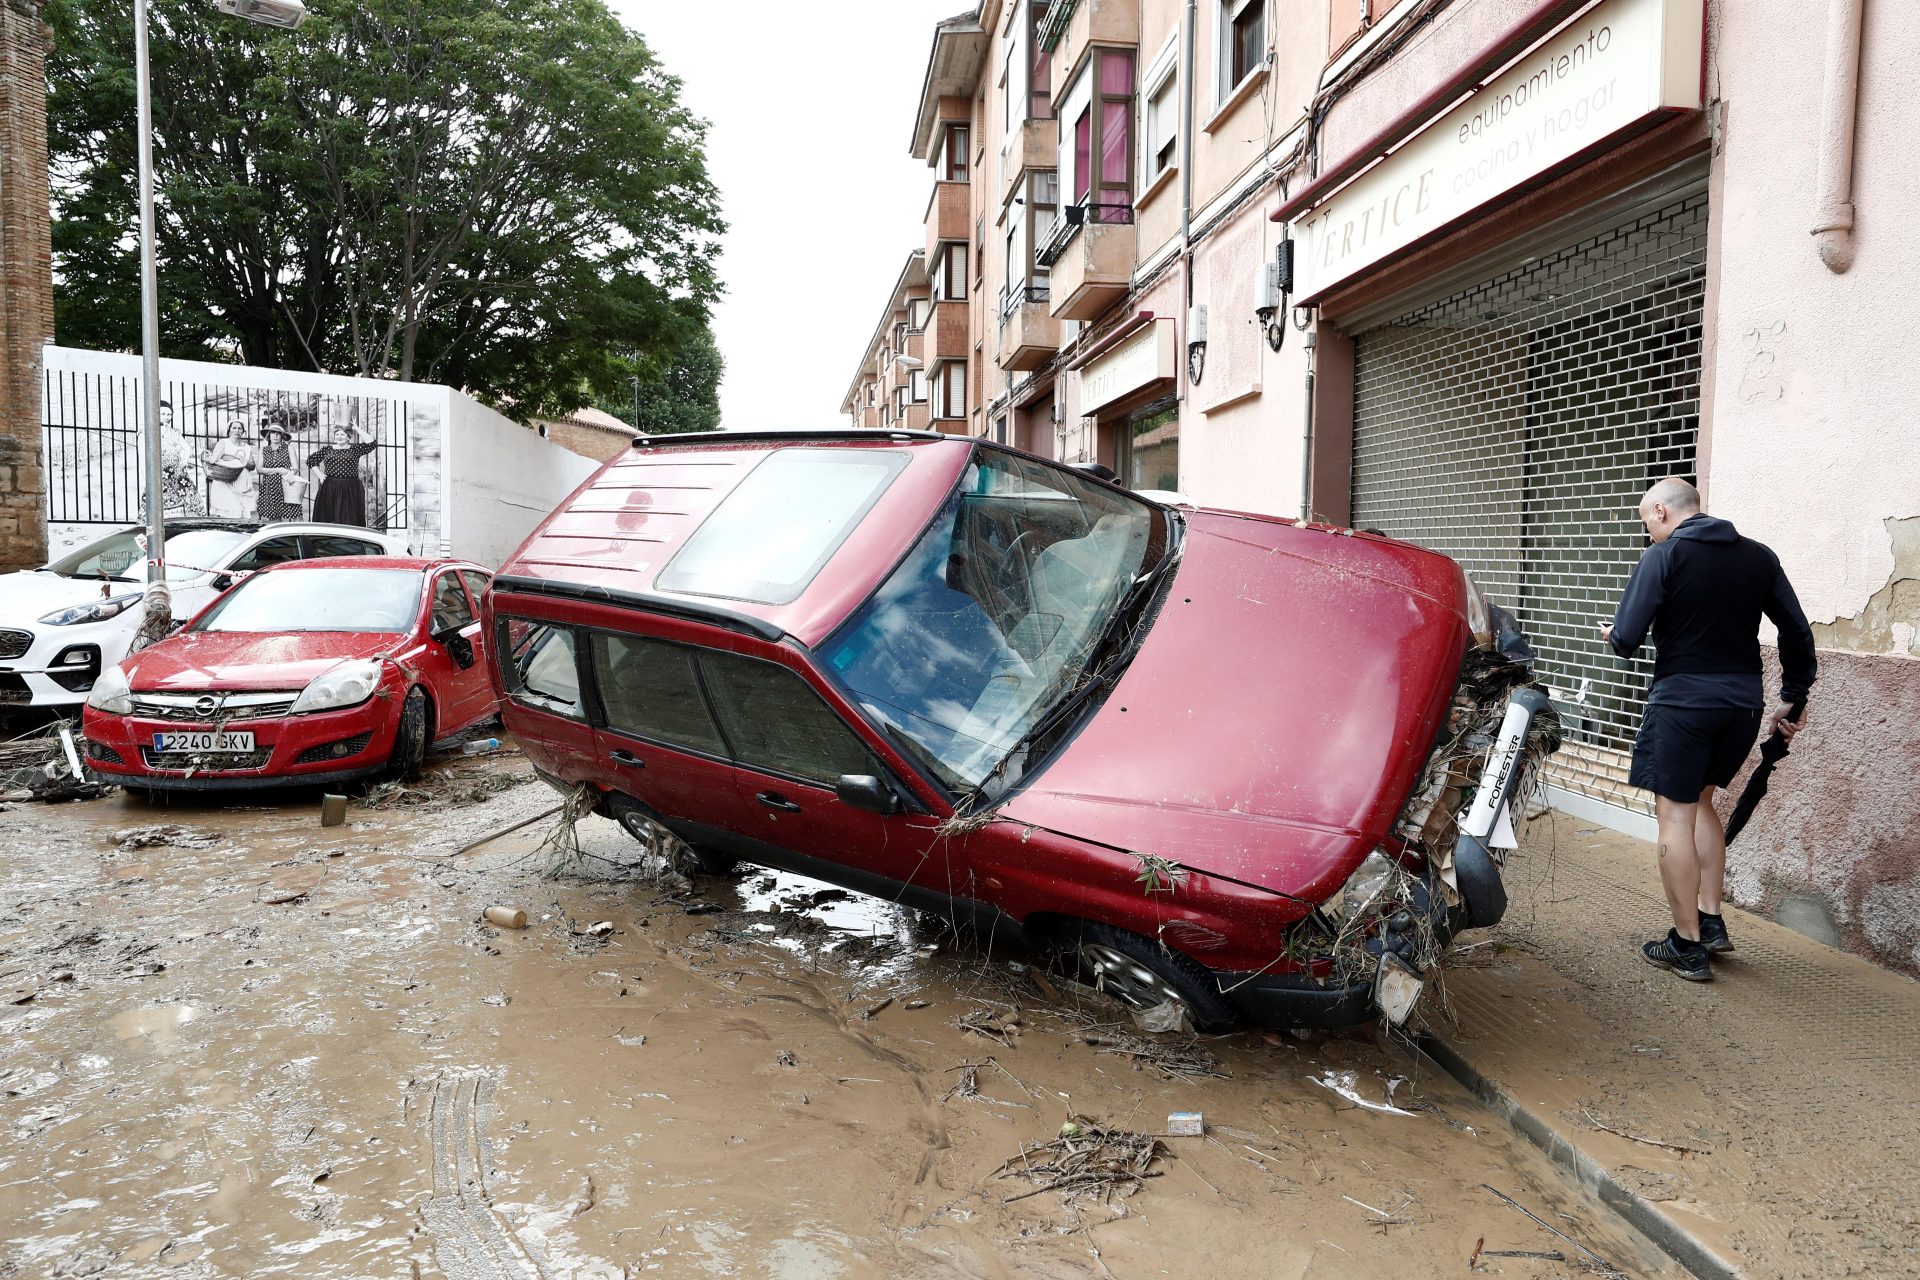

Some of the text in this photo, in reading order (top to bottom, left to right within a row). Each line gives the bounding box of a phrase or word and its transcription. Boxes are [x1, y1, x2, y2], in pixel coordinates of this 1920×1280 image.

[1453, 76, 1617, 194] cocina y hogar
[1458, 24, 1611, 144] equipamiento
[1306, 168, 1435, 289] VERTICE
[166, 734, 212, 750] 2240
[218, 734, 249, 749] GKV
[1489, 734, 1521, 810] FORESTER
